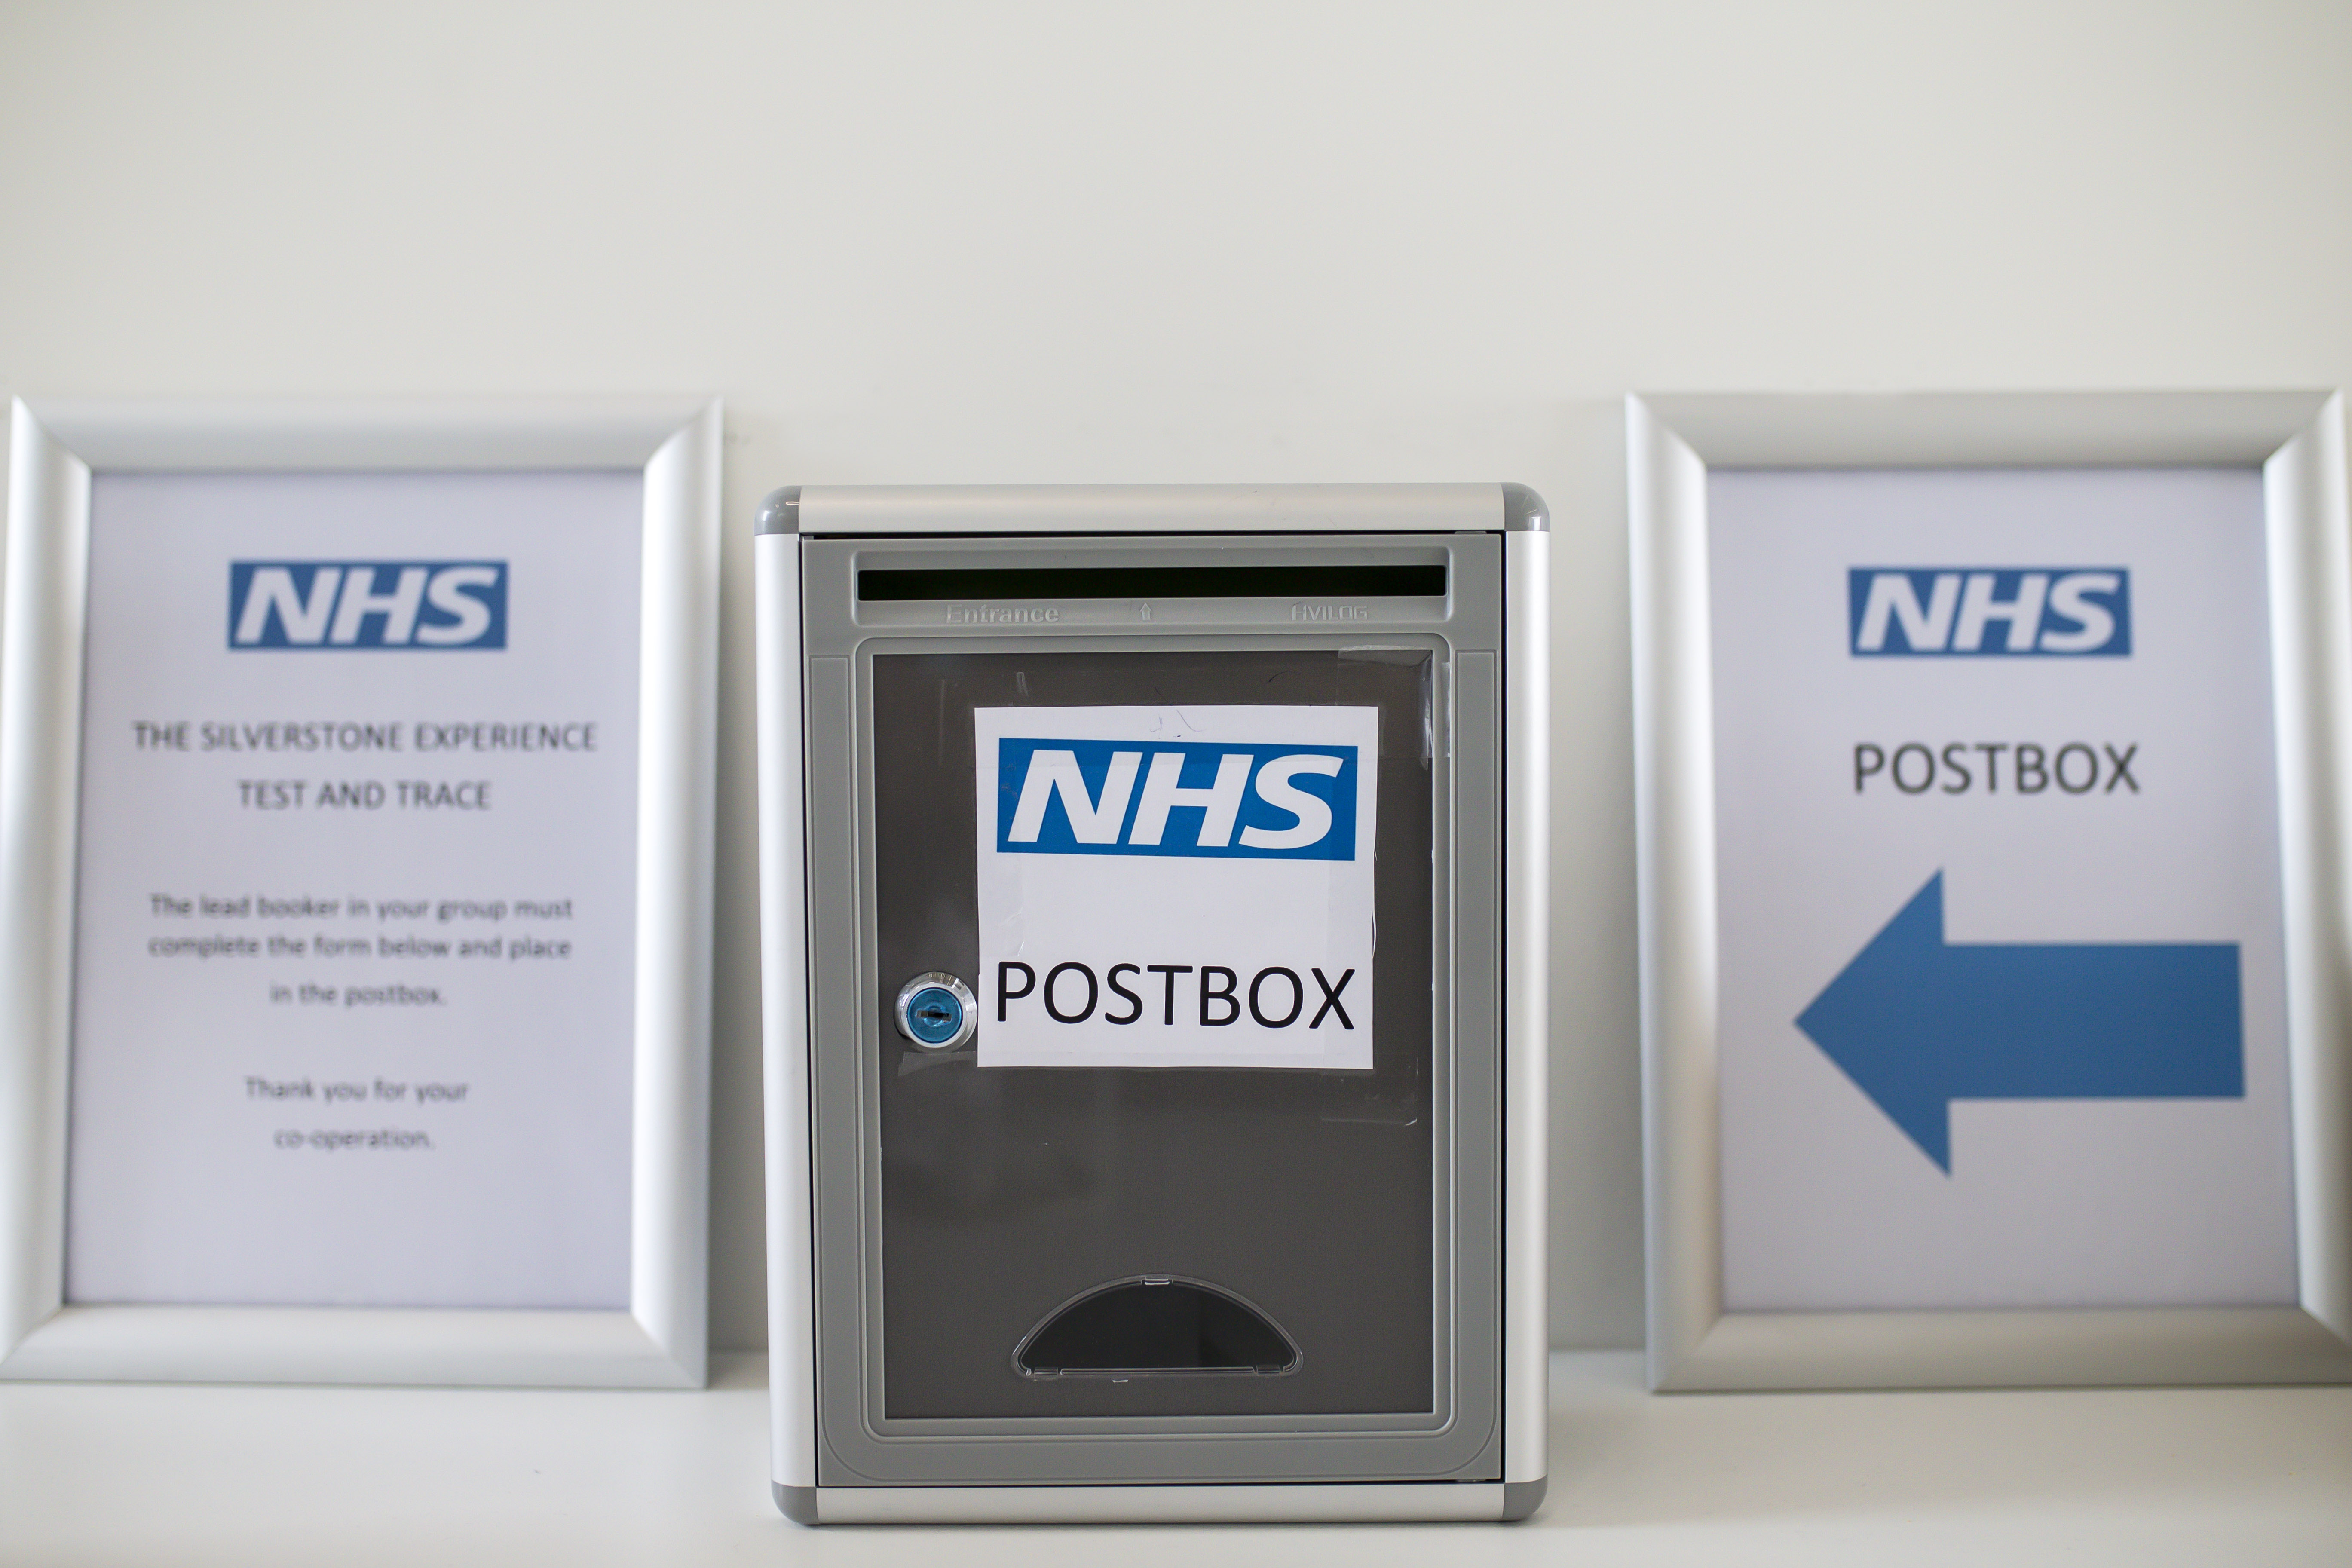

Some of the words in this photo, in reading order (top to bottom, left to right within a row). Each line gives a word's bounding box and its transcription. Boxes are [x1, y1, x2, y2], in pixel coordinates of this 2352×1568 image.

[236, 566, 498, 645] NHS
[946, 603, 1059, 623] Entrance
[1857, 572, 2119, 652] NHS
[134, 721, 190, 751] THE
[200, 722, 402, 751] SILVERSTONE
[413, 722, 597, 752] EXPERIENCE
[1854, 742, 2140, 795] POSTBOX
[238, 780, 307, 809] TEST
[316, 781, 386, 810] AND
[396, 781, 492, 810] TRACE
[1008, 749, 1344, 850] NHS
[150, 893, 193, 918] The
[199, 895, 251, 919] lead
[256, 896, 340, 919] booker
[347, 896, 371, 918] in
[376, 900, 430, 922] your
[436, 900, 508, 923] group
[514, 898, 573, 920] must
[147, 934, 261, 959] complete
[267, 935, 307, 957] the
[313, 935, 372, 958] form
[377, 936, 451, 958] below
[458, 937, 503, 959] and
[508, 937, 572, 962] place
[269, 982, 292, 1003] in
[298, 983, 337, 1004] the
[344, 983, 448, 1008] postbox.
[997, 961, 1355, 1030] POSTBOX
[245, 1075, 315, 1100] Thank
[322, 1083, 367, 1103] you
[374, 1078, 407, 1100] for
[414, 1083, 469, 1104] your
[273, 1128, 436, 1151] co-operation.
